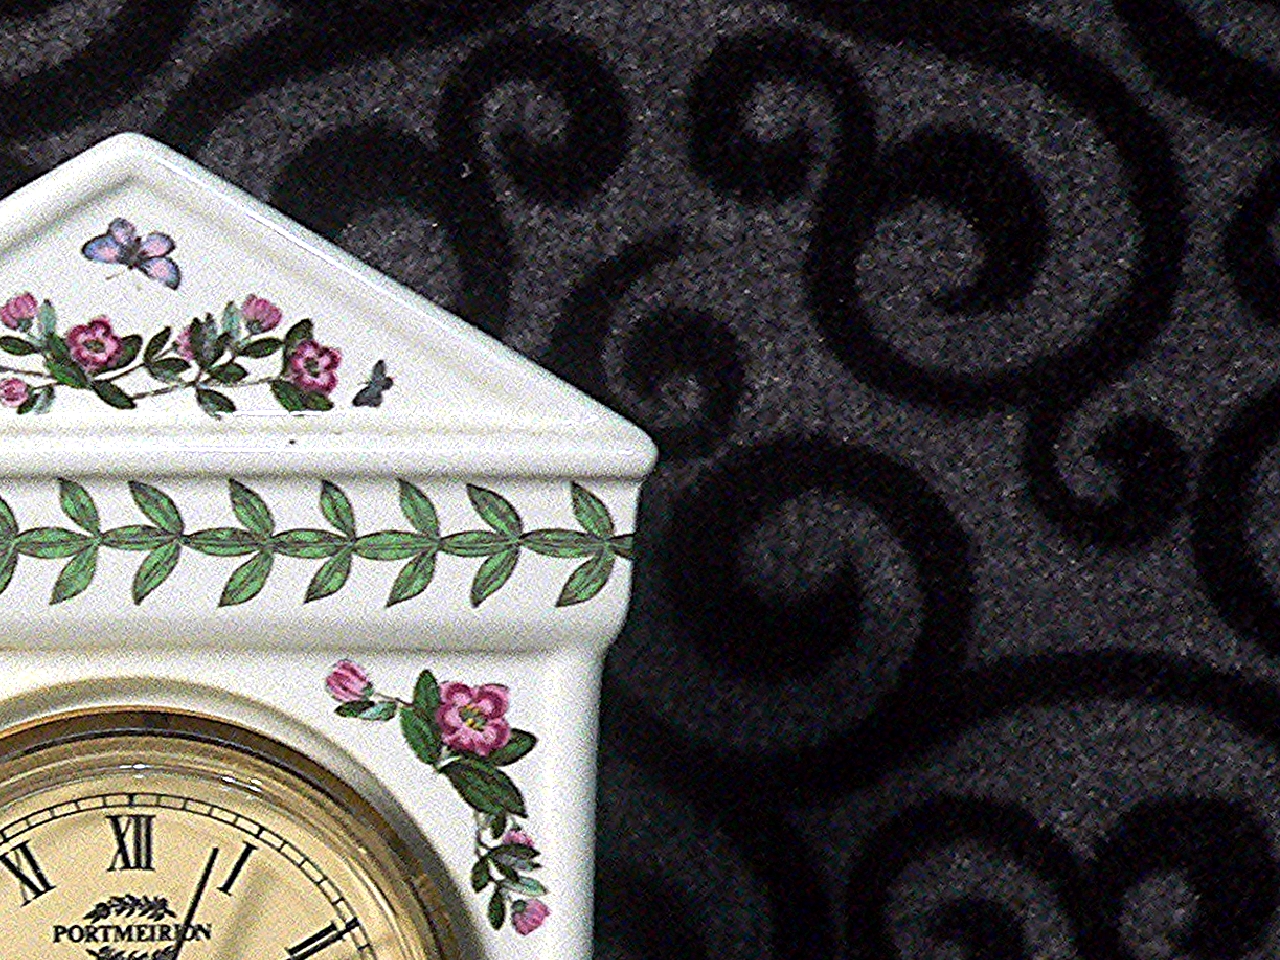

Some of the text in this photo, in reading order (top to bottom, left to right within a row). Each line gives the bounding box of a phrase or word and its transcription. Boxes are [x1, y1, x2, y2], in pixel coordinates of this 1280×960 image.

[106, 814, 155, 872] XII
[217, 842, 259, 896] I
[52, 922, 212, 944] PORTMEIRION
